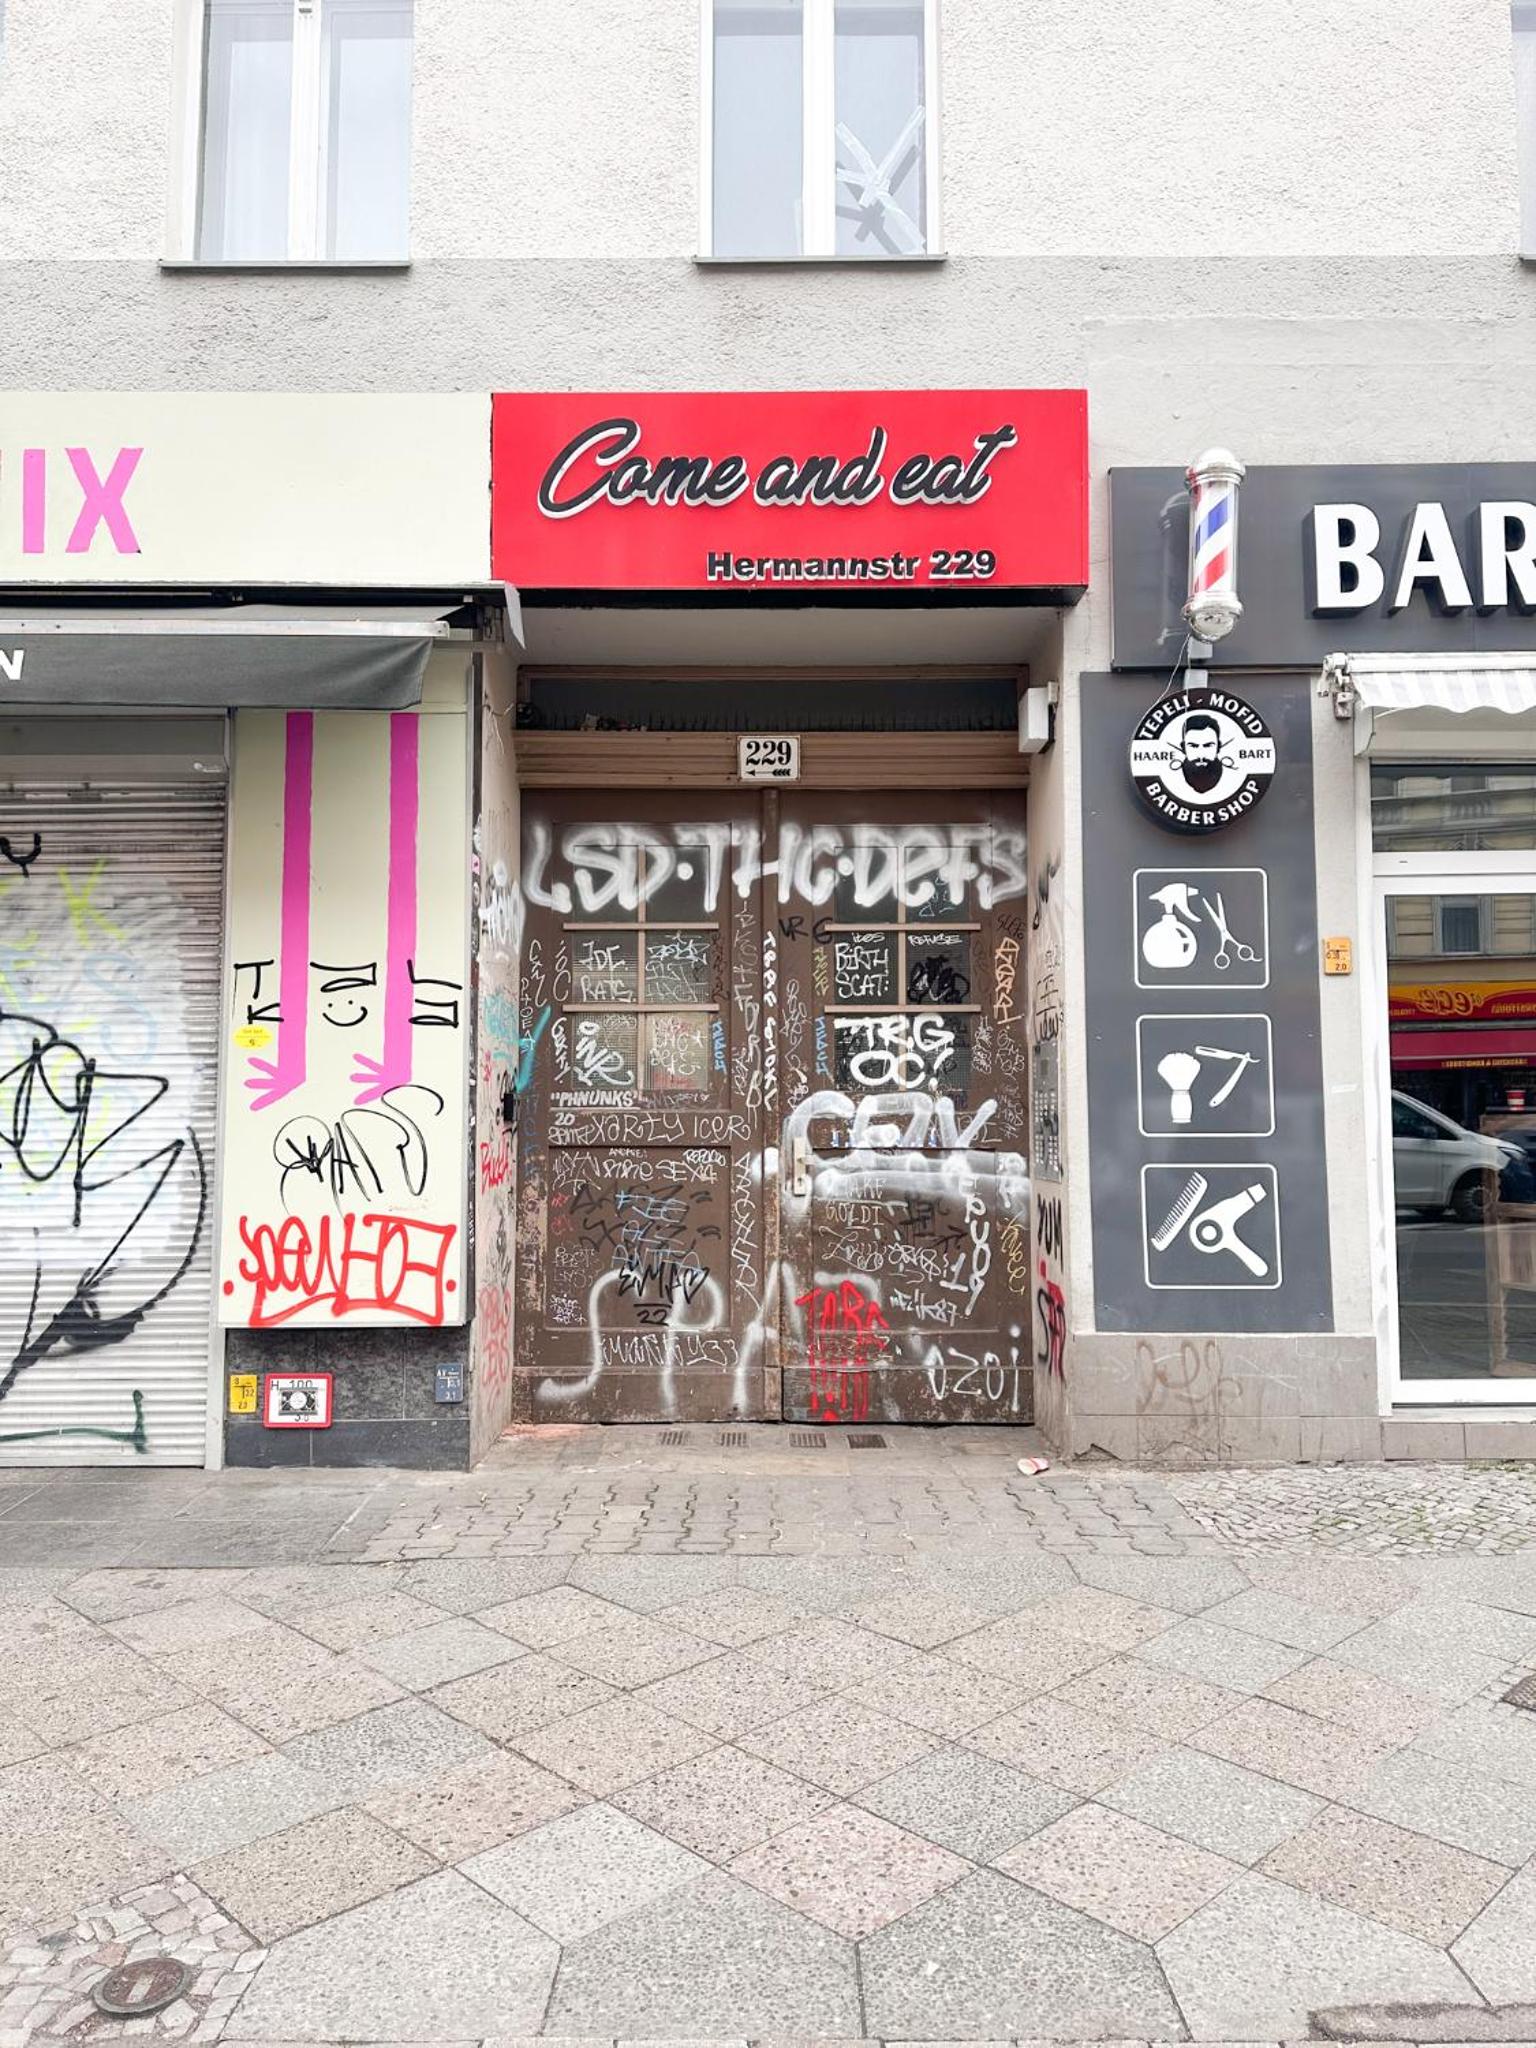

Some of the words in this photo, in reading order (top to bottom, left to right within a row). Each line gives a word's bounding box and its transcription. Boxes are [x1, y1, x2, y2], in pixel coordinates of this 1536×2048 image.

[538, 418, 750, 519] Come
[753, 426, 887, 506] and
[891, 425, 1018, 506] eat
[706, 551, 919, 581] Hermannstr
[928, 549, 997, 580] 229
[1313, 501, 1536, 609] BAR
[1138, 694, 1191, 740] TEPELI
[1209, 693, 1263, 735] MOFID
[745, 740, 792, 767] 229
[1239, 749, 1272, 760] BART
